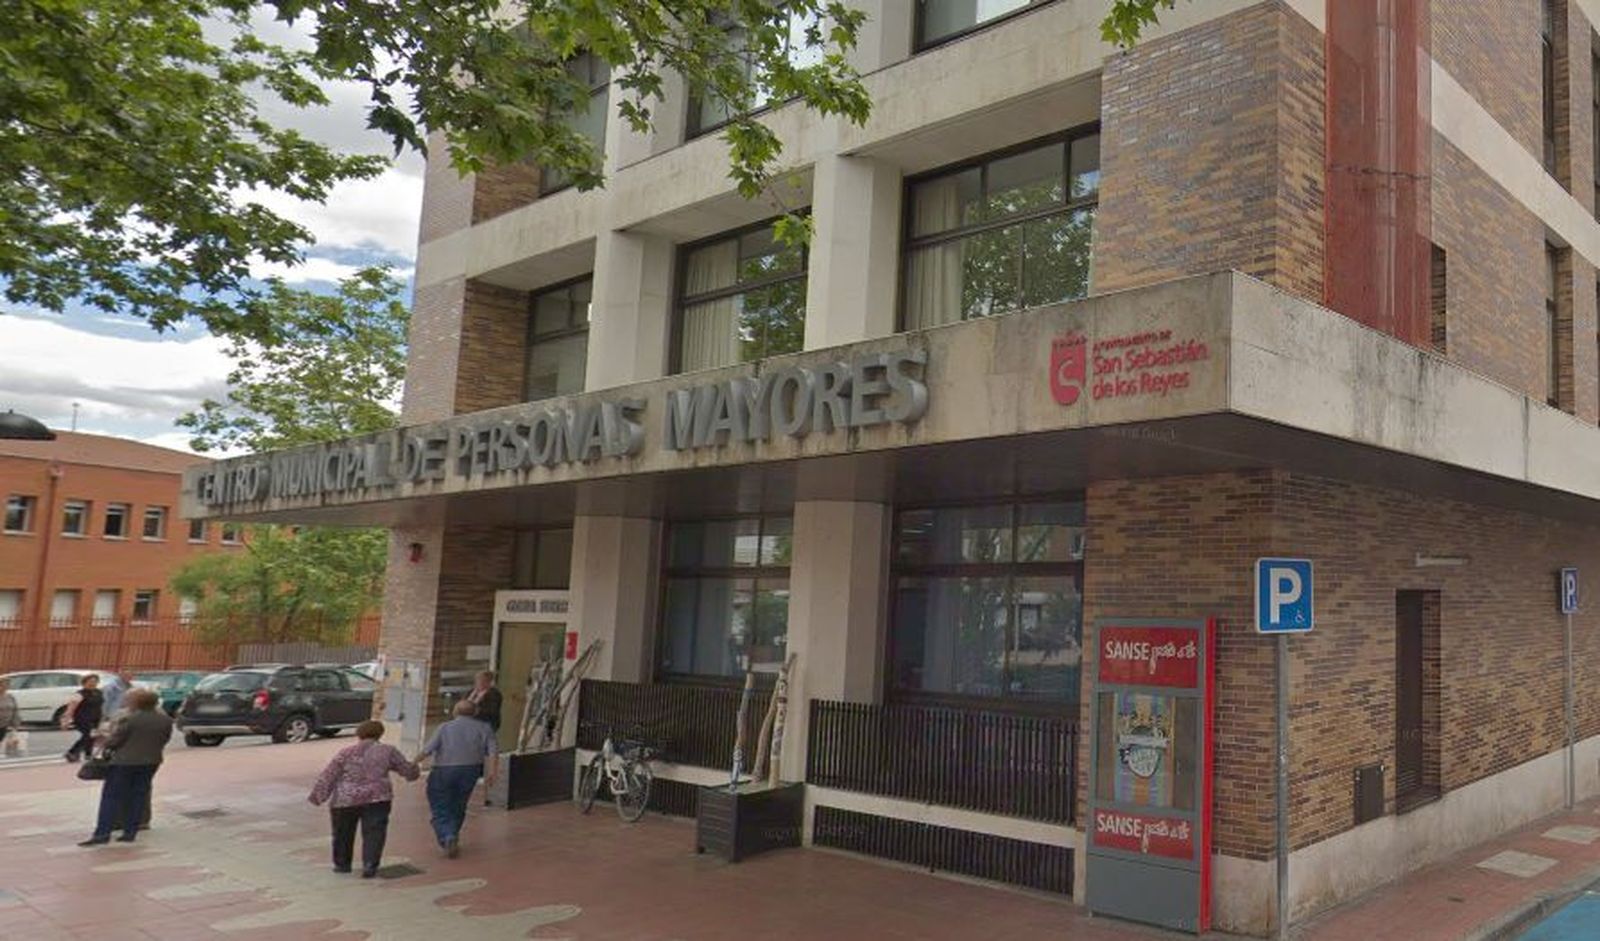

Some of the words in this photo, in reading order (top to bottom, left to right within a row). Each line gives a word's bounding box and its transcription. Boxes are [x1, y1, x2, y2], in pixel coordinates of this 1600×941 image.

[1093, 356, 1122, 375] San
[1126, 339, 1208, 373] Sebastián
[1093, 377, 1113, 400] de
[1114, 376, 1138, 397] los
[1141, 372, 1190, 397] Reyes
[269, 442, 396, 497] MUNICIPAL
[401, 430, 449, 481] DE
[455, 397, 646, 477] PERSONAS
[664, 348, 930, 451] MAYORES
[1269, 567, 1302, 624] P
[1566, 573, 1576, 608] P
[1104, 641, 1150, 660] SANSE
[1097, 813, 1141, 837] SANSE
